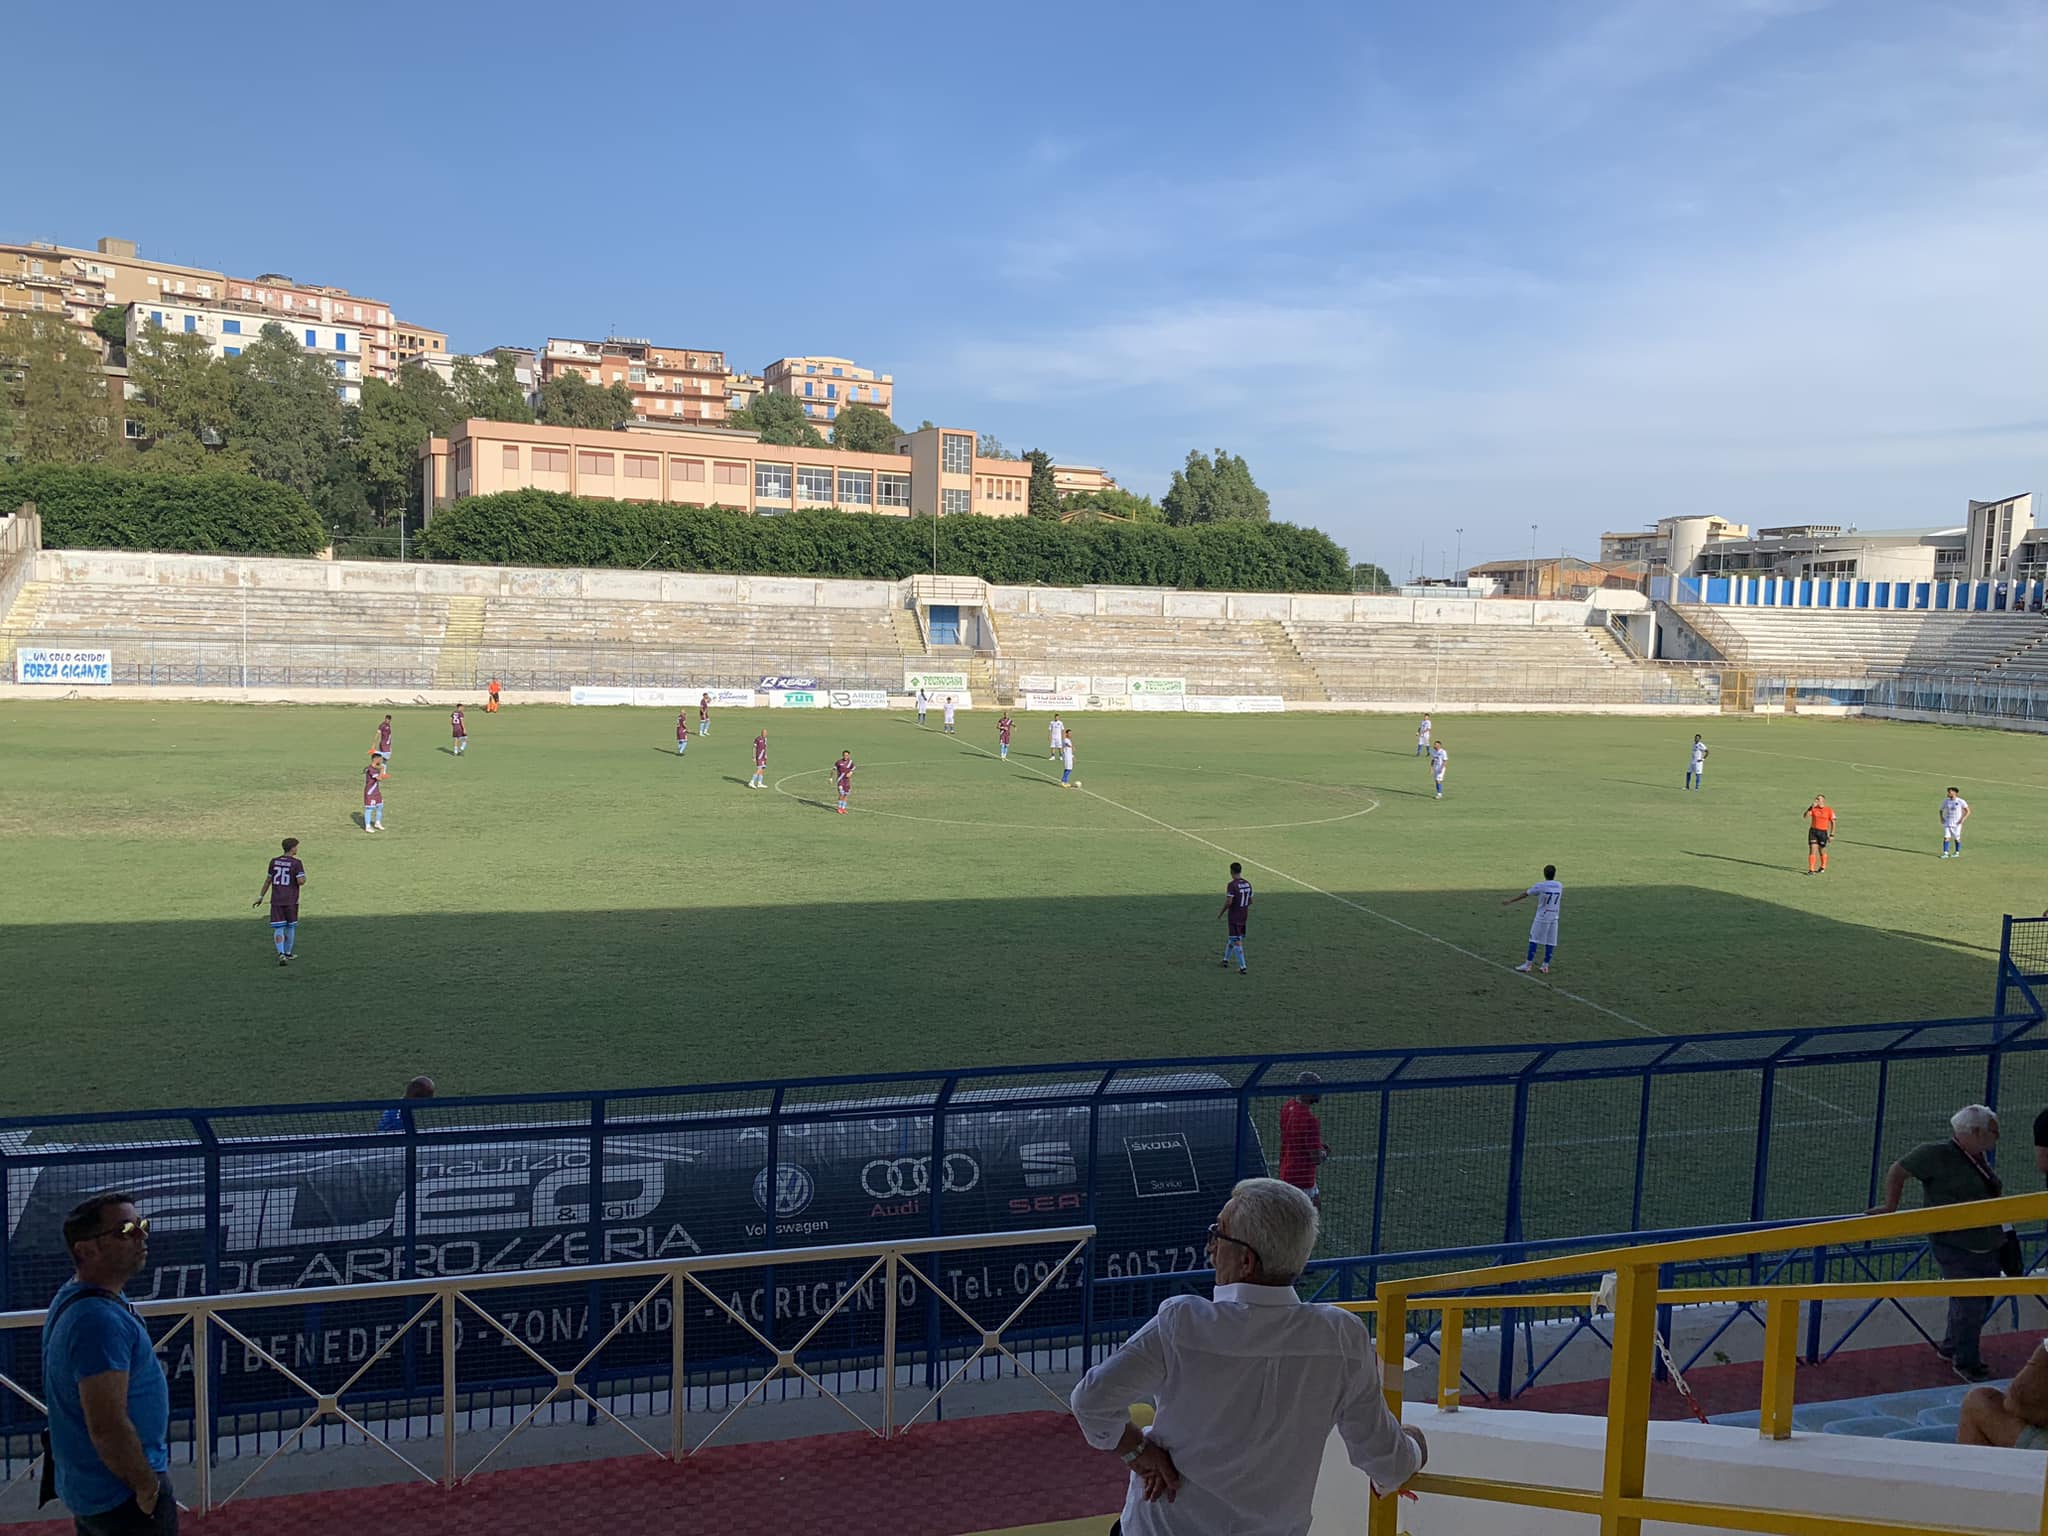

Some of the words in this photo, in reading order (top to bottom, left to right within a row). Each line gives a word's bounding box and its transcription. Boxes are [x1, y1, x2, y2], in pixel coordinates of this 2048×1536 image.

[49, 653, 71, 661] SOLO
[74, 653, 105, 662] GRIDO!
[24, 663, 58, 678] FORZA
[61, 664, 108, 678] GIGANTE
[273, 866, 290, 885] 26
[1545, 892, 1560, 905] 77
[870, 1200, 919, 1216] Audi
[745, 1219, 829, 1237] Volswagen
[128, 1223, 702, 1302] UTOCARROZZERIA
[947, 1267, 1002, 1303] Tel.
